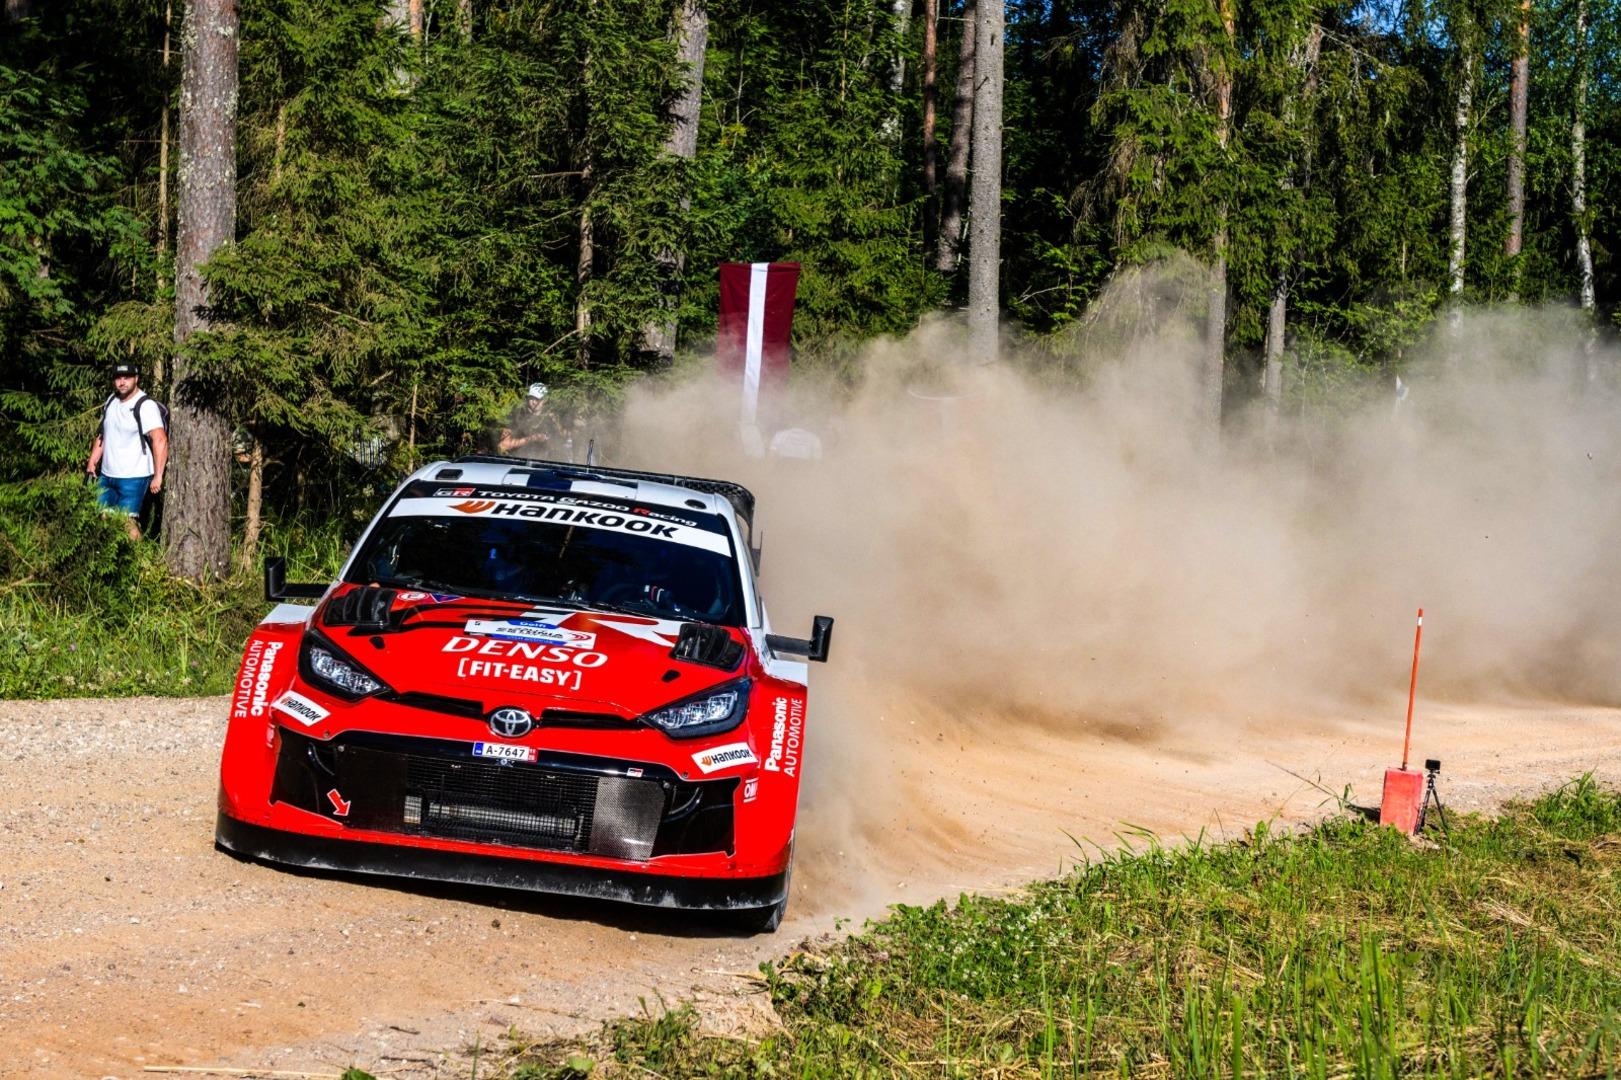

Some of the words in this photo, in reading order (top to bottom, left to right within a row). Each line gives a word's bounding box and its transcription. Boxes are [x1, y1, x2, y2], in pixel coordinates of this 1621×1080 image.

[478, 490, 555, 501] TOYOTA
[556, 496, 630, 512] GAZOO
[632, 507, 698, 527] Racing
[234, 640, 264, 718] AUTOMOTIVE
[250, 642, 284, 716] Panasonic
[441, 636, 608, 668] DENSO
[485, 745, 526, 758] A-7647
[764, 696, 788, 772] Panasonic
[783, 698, 803, 778] AUTOMOTIVE
